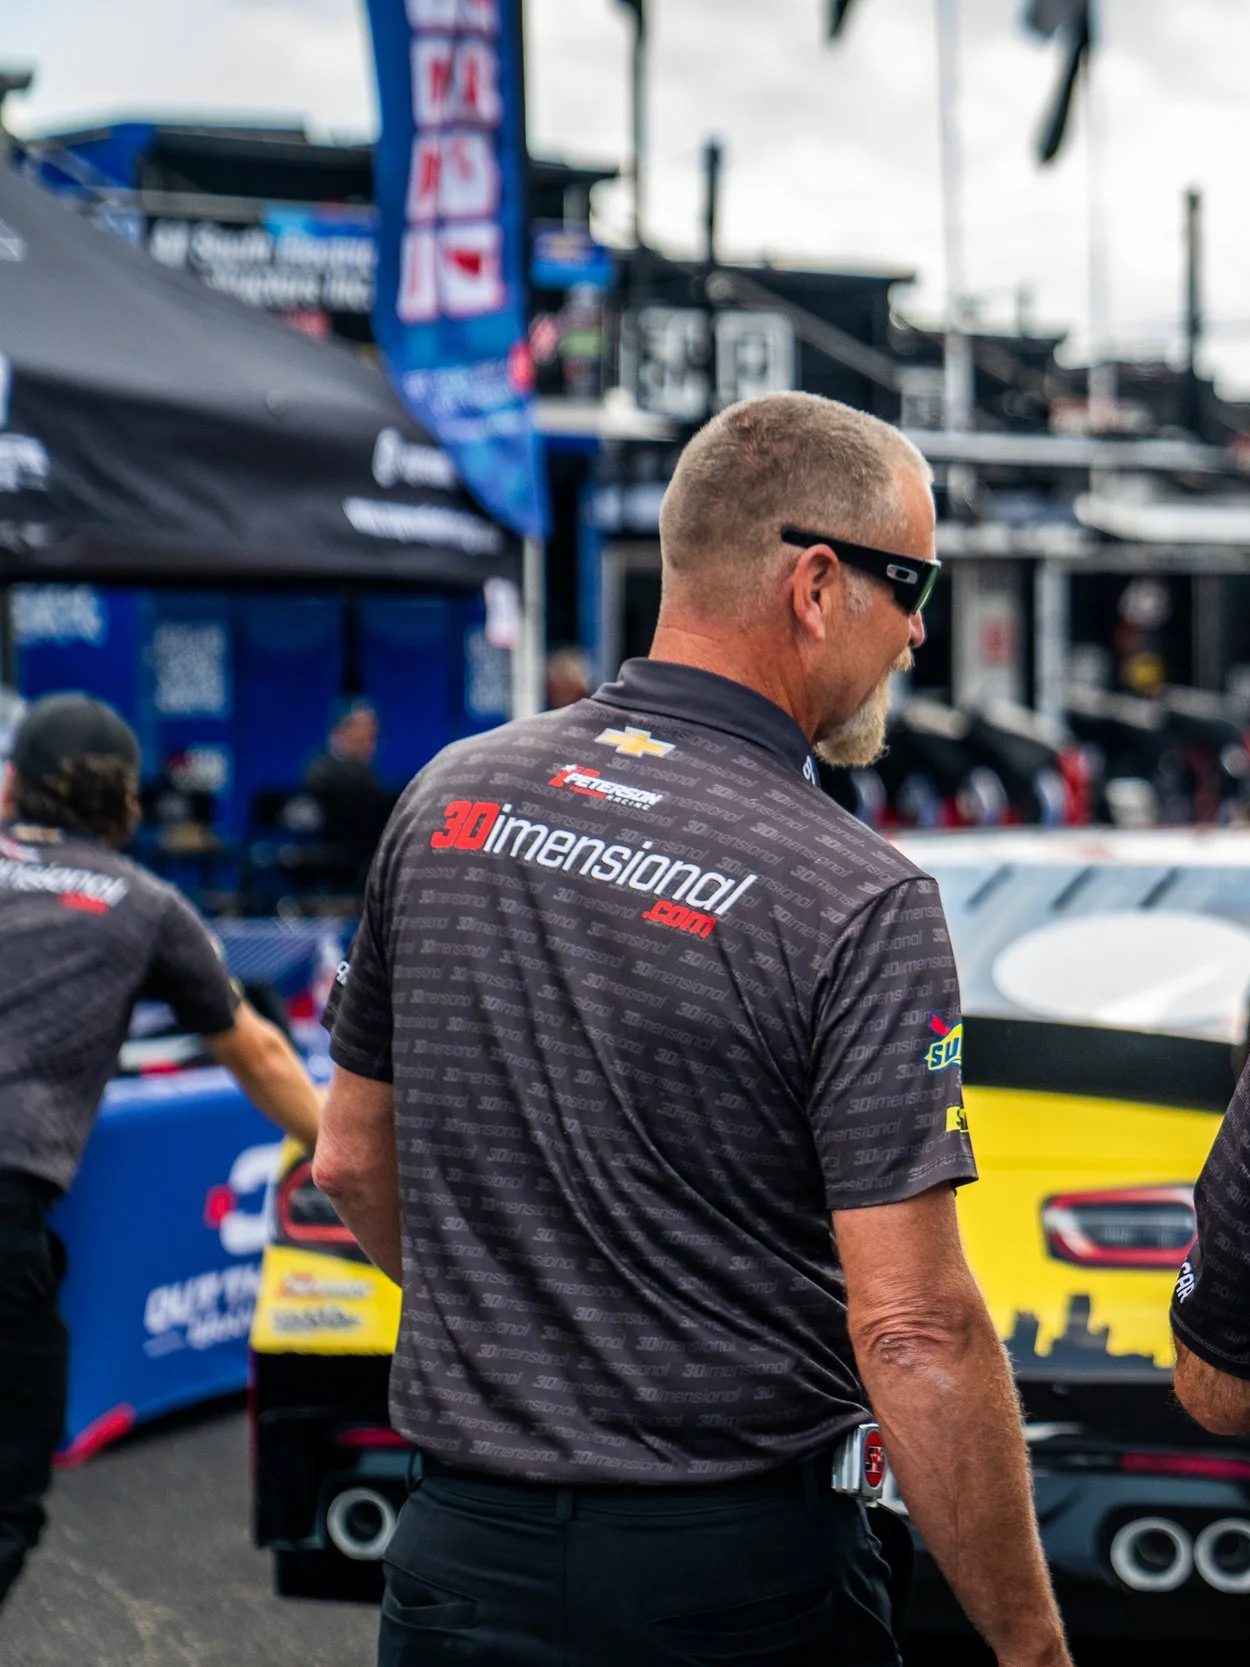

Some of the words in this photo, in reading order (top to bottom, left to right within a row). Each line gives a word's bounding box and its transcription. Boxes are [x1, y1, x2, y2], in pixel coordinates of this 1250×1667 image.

[563, 772, 663, 806] PETERSON
[430, 800, 757, 915] 3Dimensional
[641, 900, 716, 938] .com
